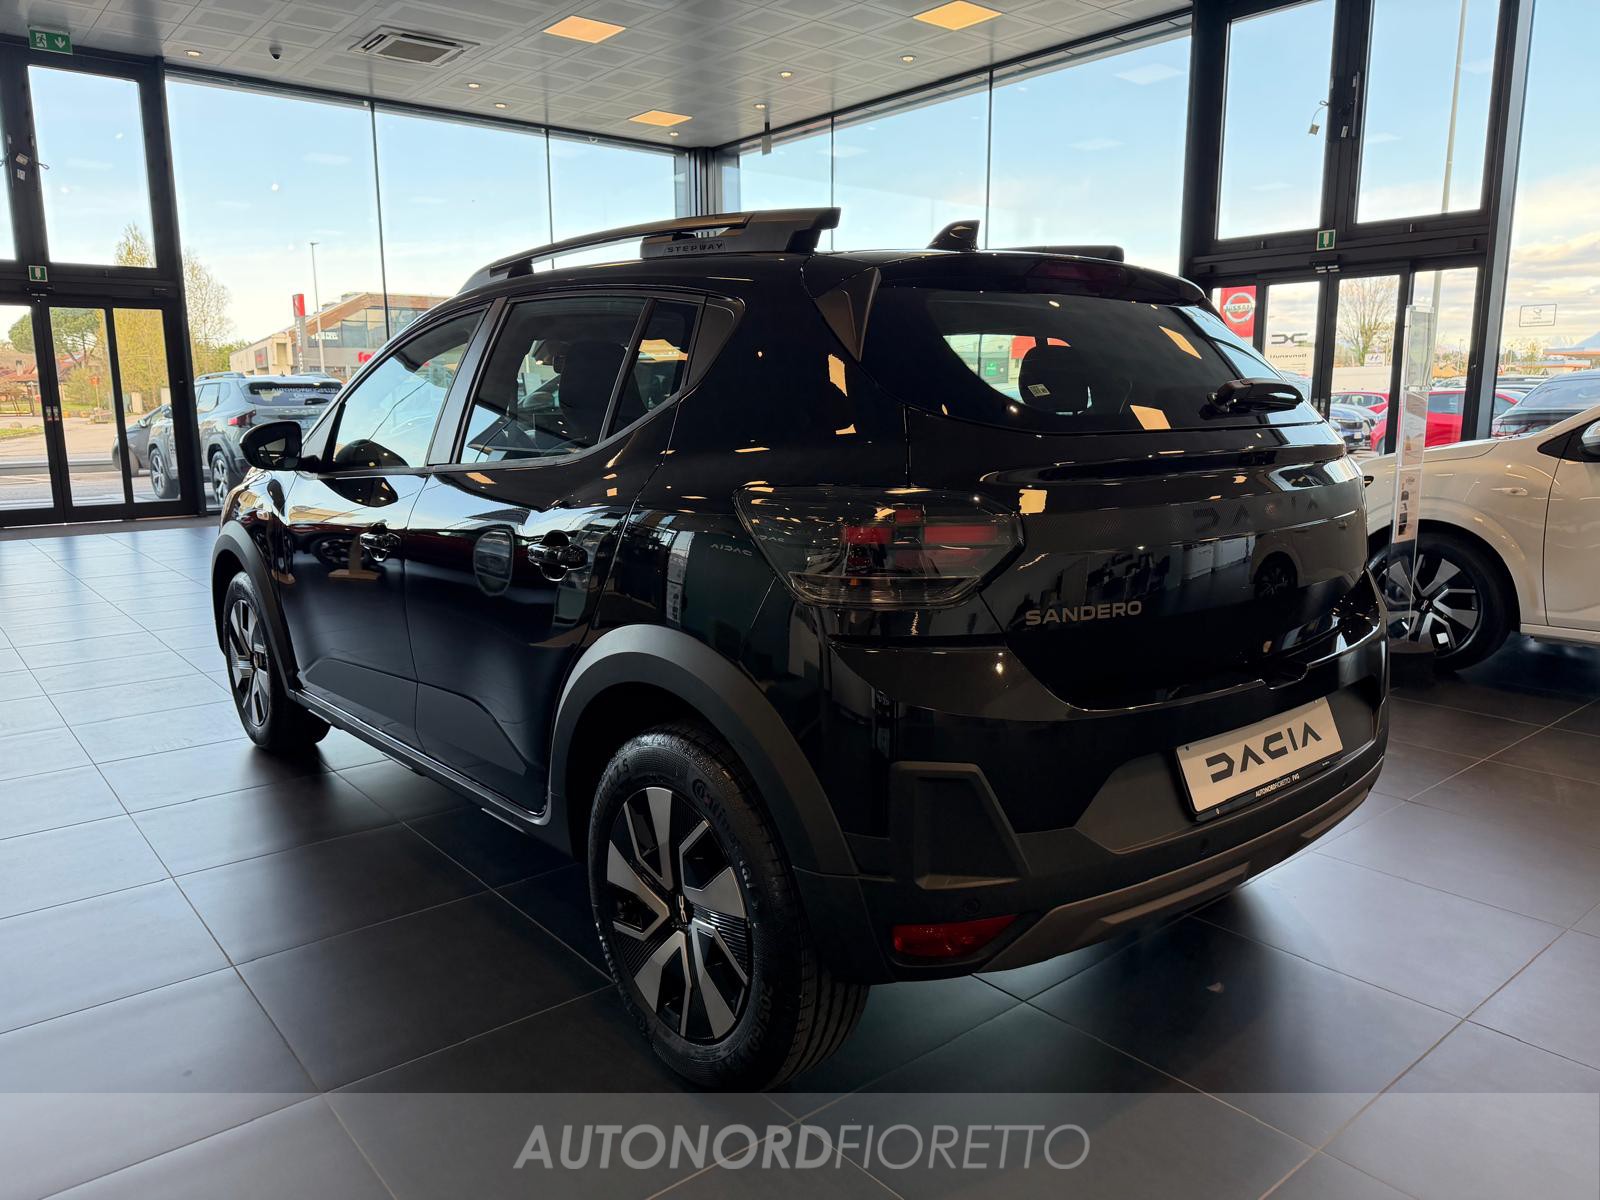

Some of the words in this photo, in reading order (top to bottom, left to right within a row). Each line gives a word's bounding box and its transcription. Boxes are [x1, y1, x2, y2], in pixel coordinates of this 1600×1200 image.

[667, 243, 723, 253] STEPWAY
[1025, 600, 1143, 627] SANDERO
[1205, 722, 1322, 784] DACIA
